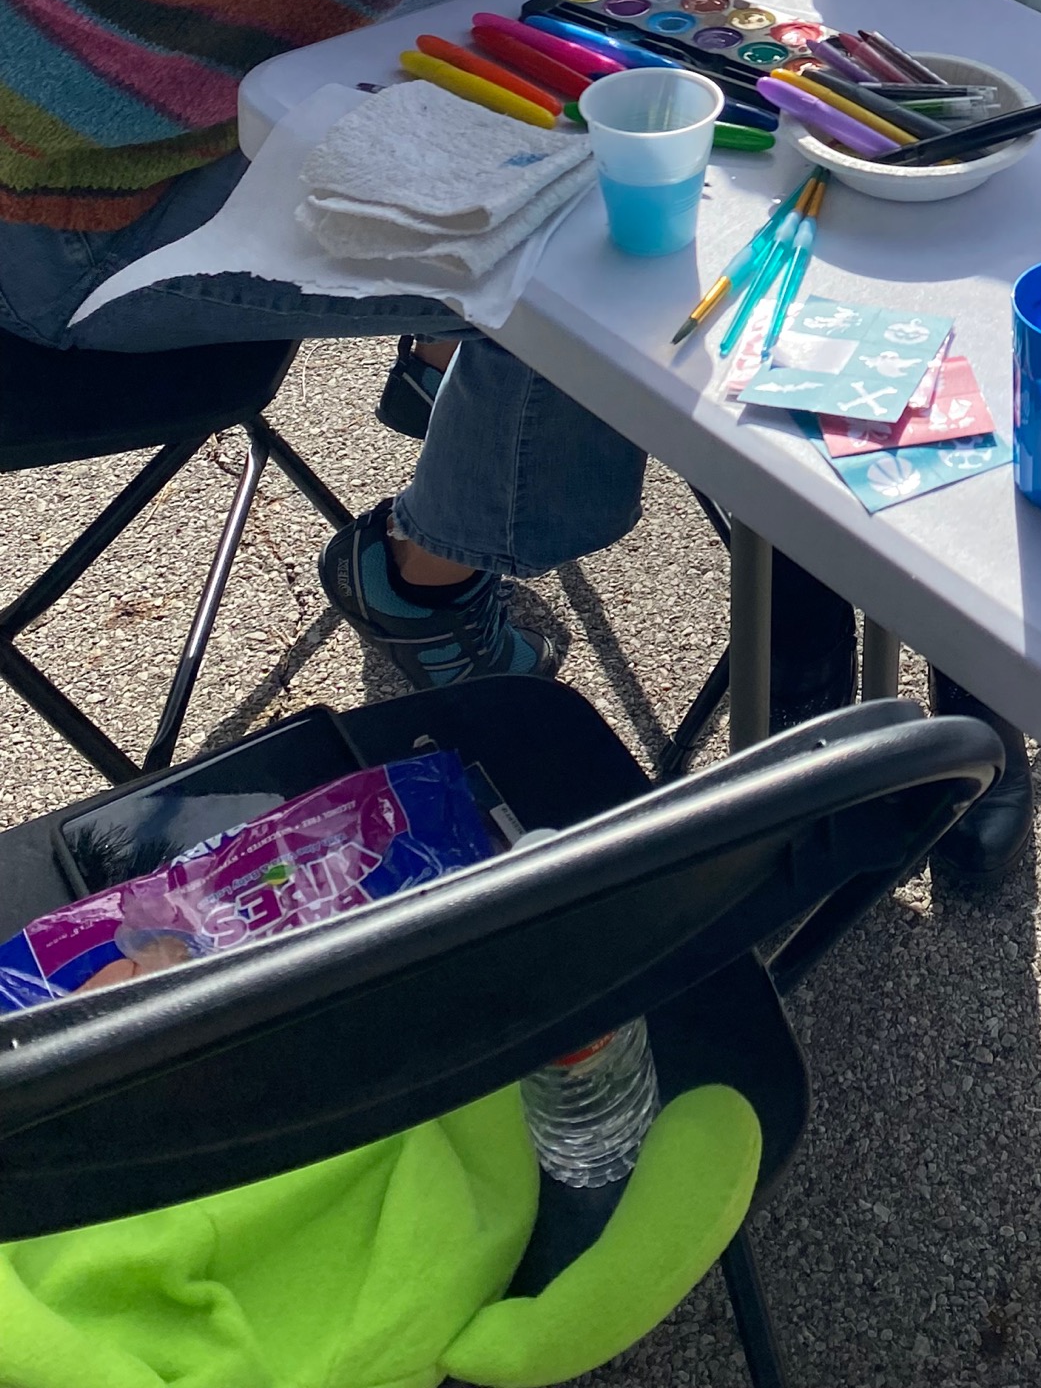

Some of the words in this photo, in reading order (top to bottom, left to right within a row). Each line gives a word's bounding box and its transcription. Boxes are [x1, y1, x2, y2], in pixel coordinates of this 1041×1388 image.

[322, 800, 357, 819] ALCOHOL
[301, 815, 322, 829] FREE
[232, 868, 261, 891] Baby
[201, 841, 384, 950] WIPES
